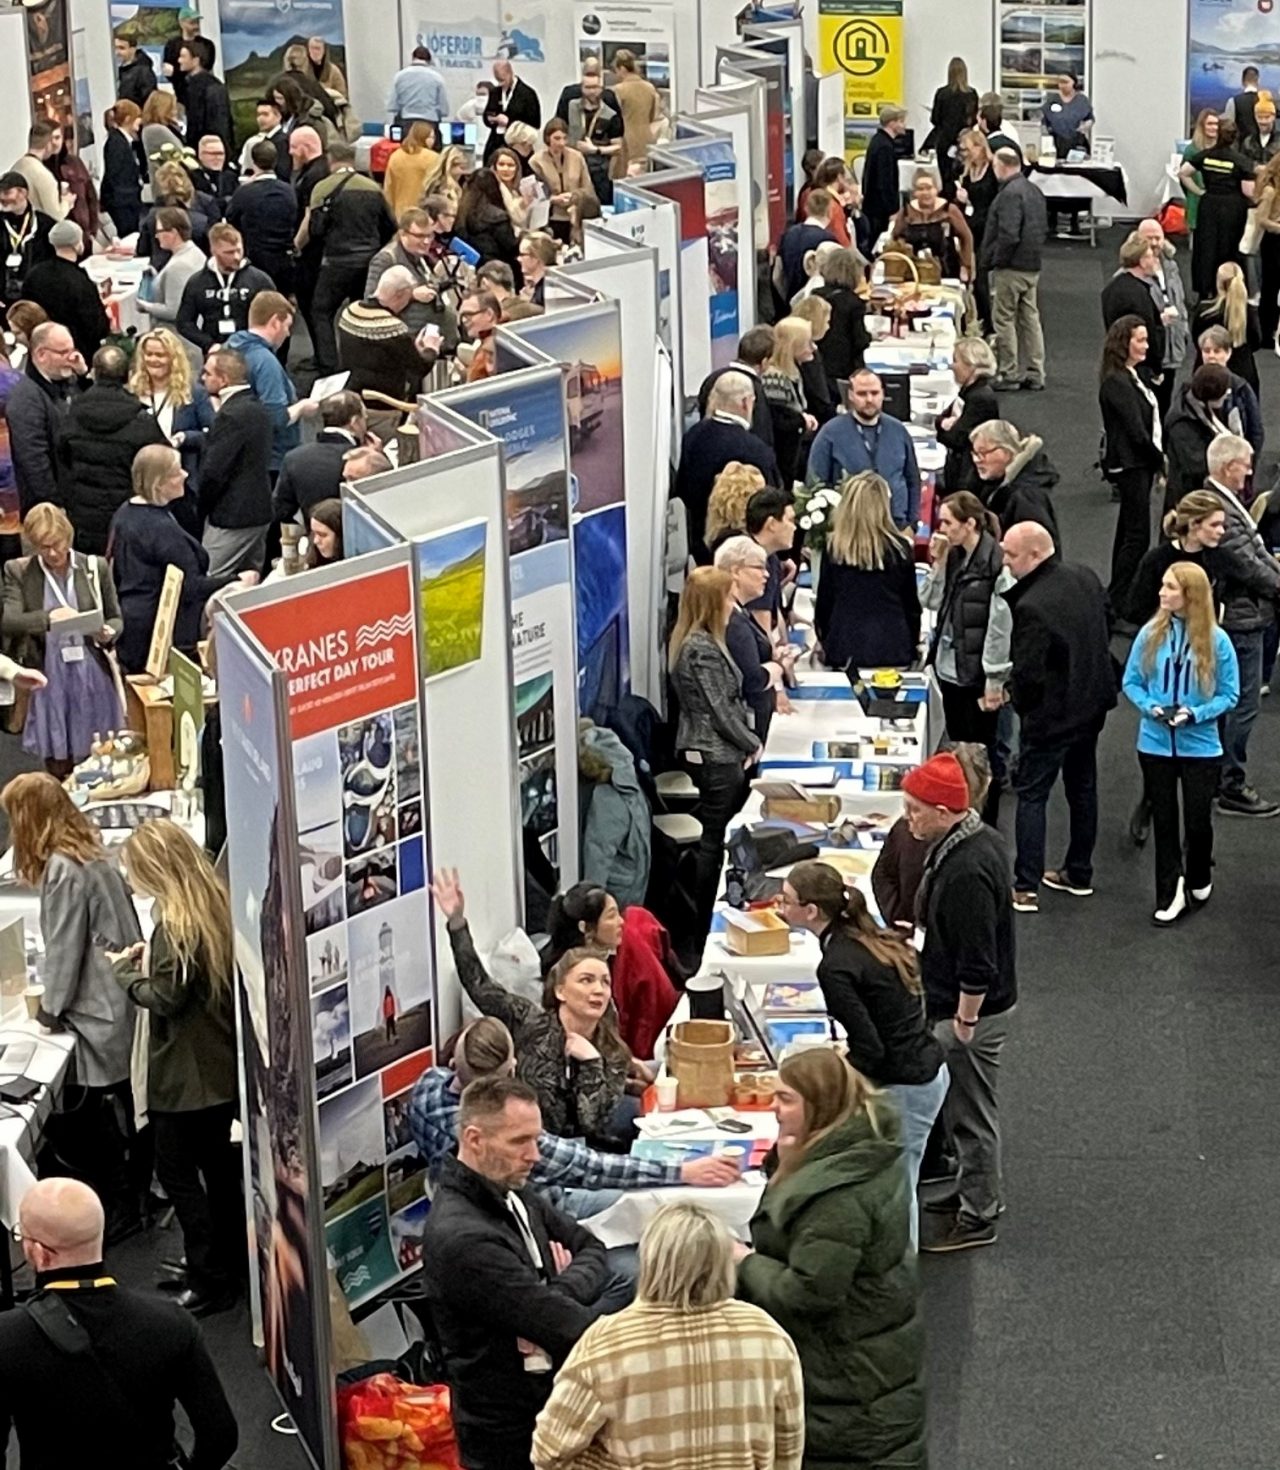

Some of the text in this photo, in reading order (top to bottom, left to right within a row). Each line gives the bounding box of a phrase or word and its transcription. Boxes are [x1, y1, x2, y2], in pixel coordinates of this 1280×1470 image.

[271, 630, 349, 673] KRANES
[288, 667, 331, 696] ERFECT
[334, 657, 360, 682] DAY
[361, 647, 395, 672] TOUR
